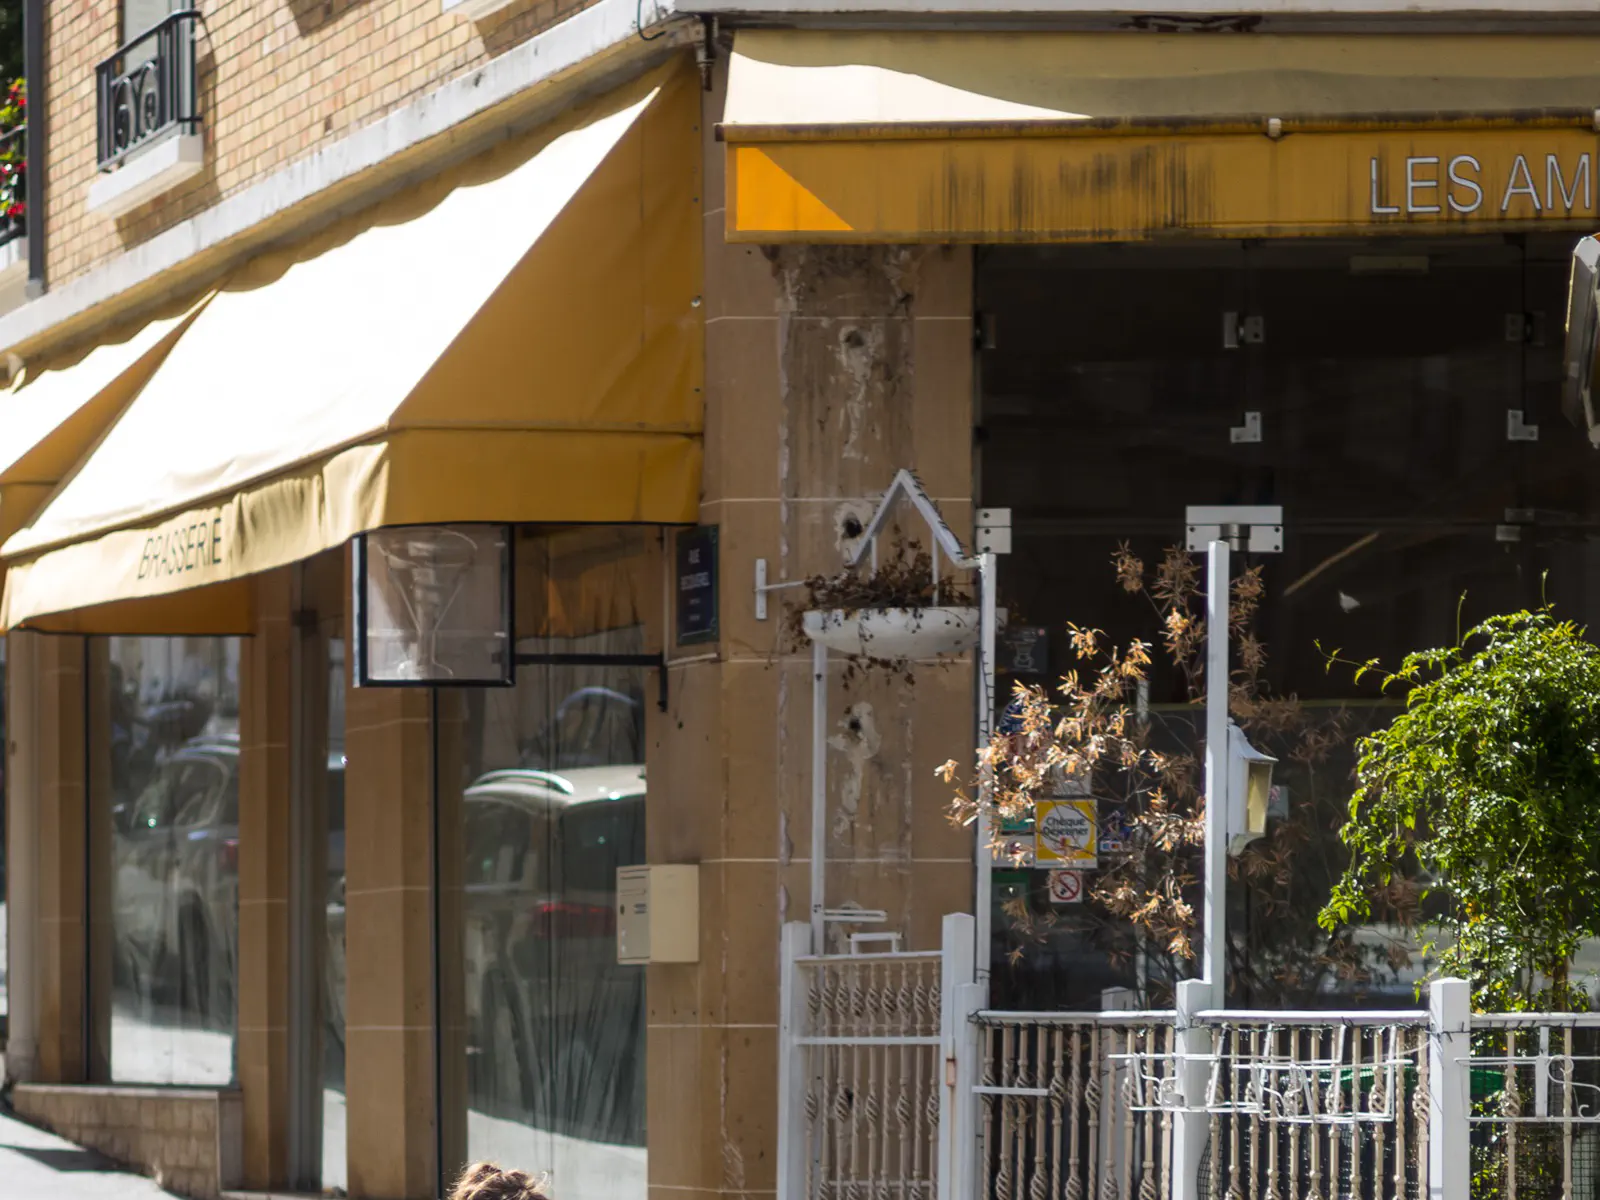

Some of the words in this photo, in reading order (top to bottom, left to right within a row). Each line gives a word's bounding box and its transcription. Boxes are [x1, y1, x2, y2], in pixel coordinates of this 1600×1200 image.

[1370, 154, 1483, 214] LES
[1500, 152, 1591, 212] AM
[137, 517, 222, 580] BRASSERIE
